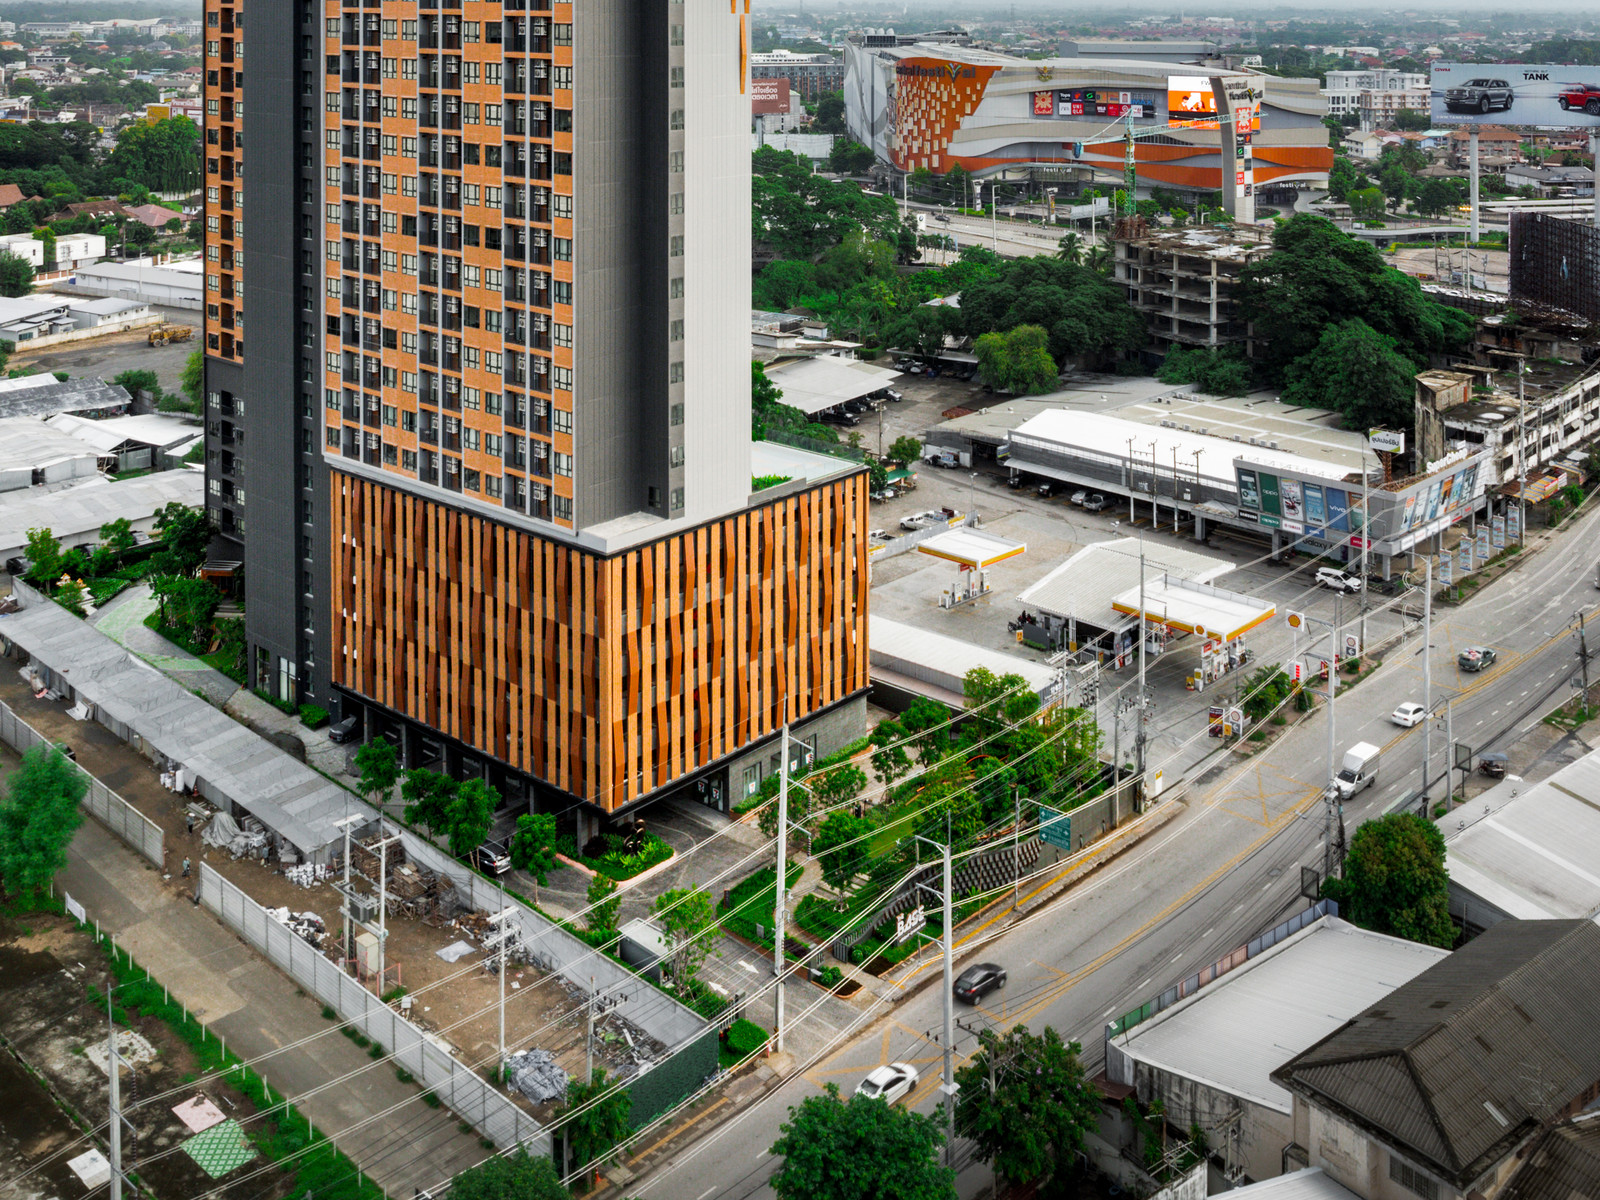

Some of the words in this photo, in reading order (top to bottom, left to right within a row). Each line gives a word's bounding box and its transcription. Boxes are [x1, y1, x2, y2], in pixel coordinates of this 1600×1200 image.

[1522, 73, 1549, 81] TANK
[1329, 505, 1346, 513] vivo
[1303, 538, 1327, 551] Galaxy
